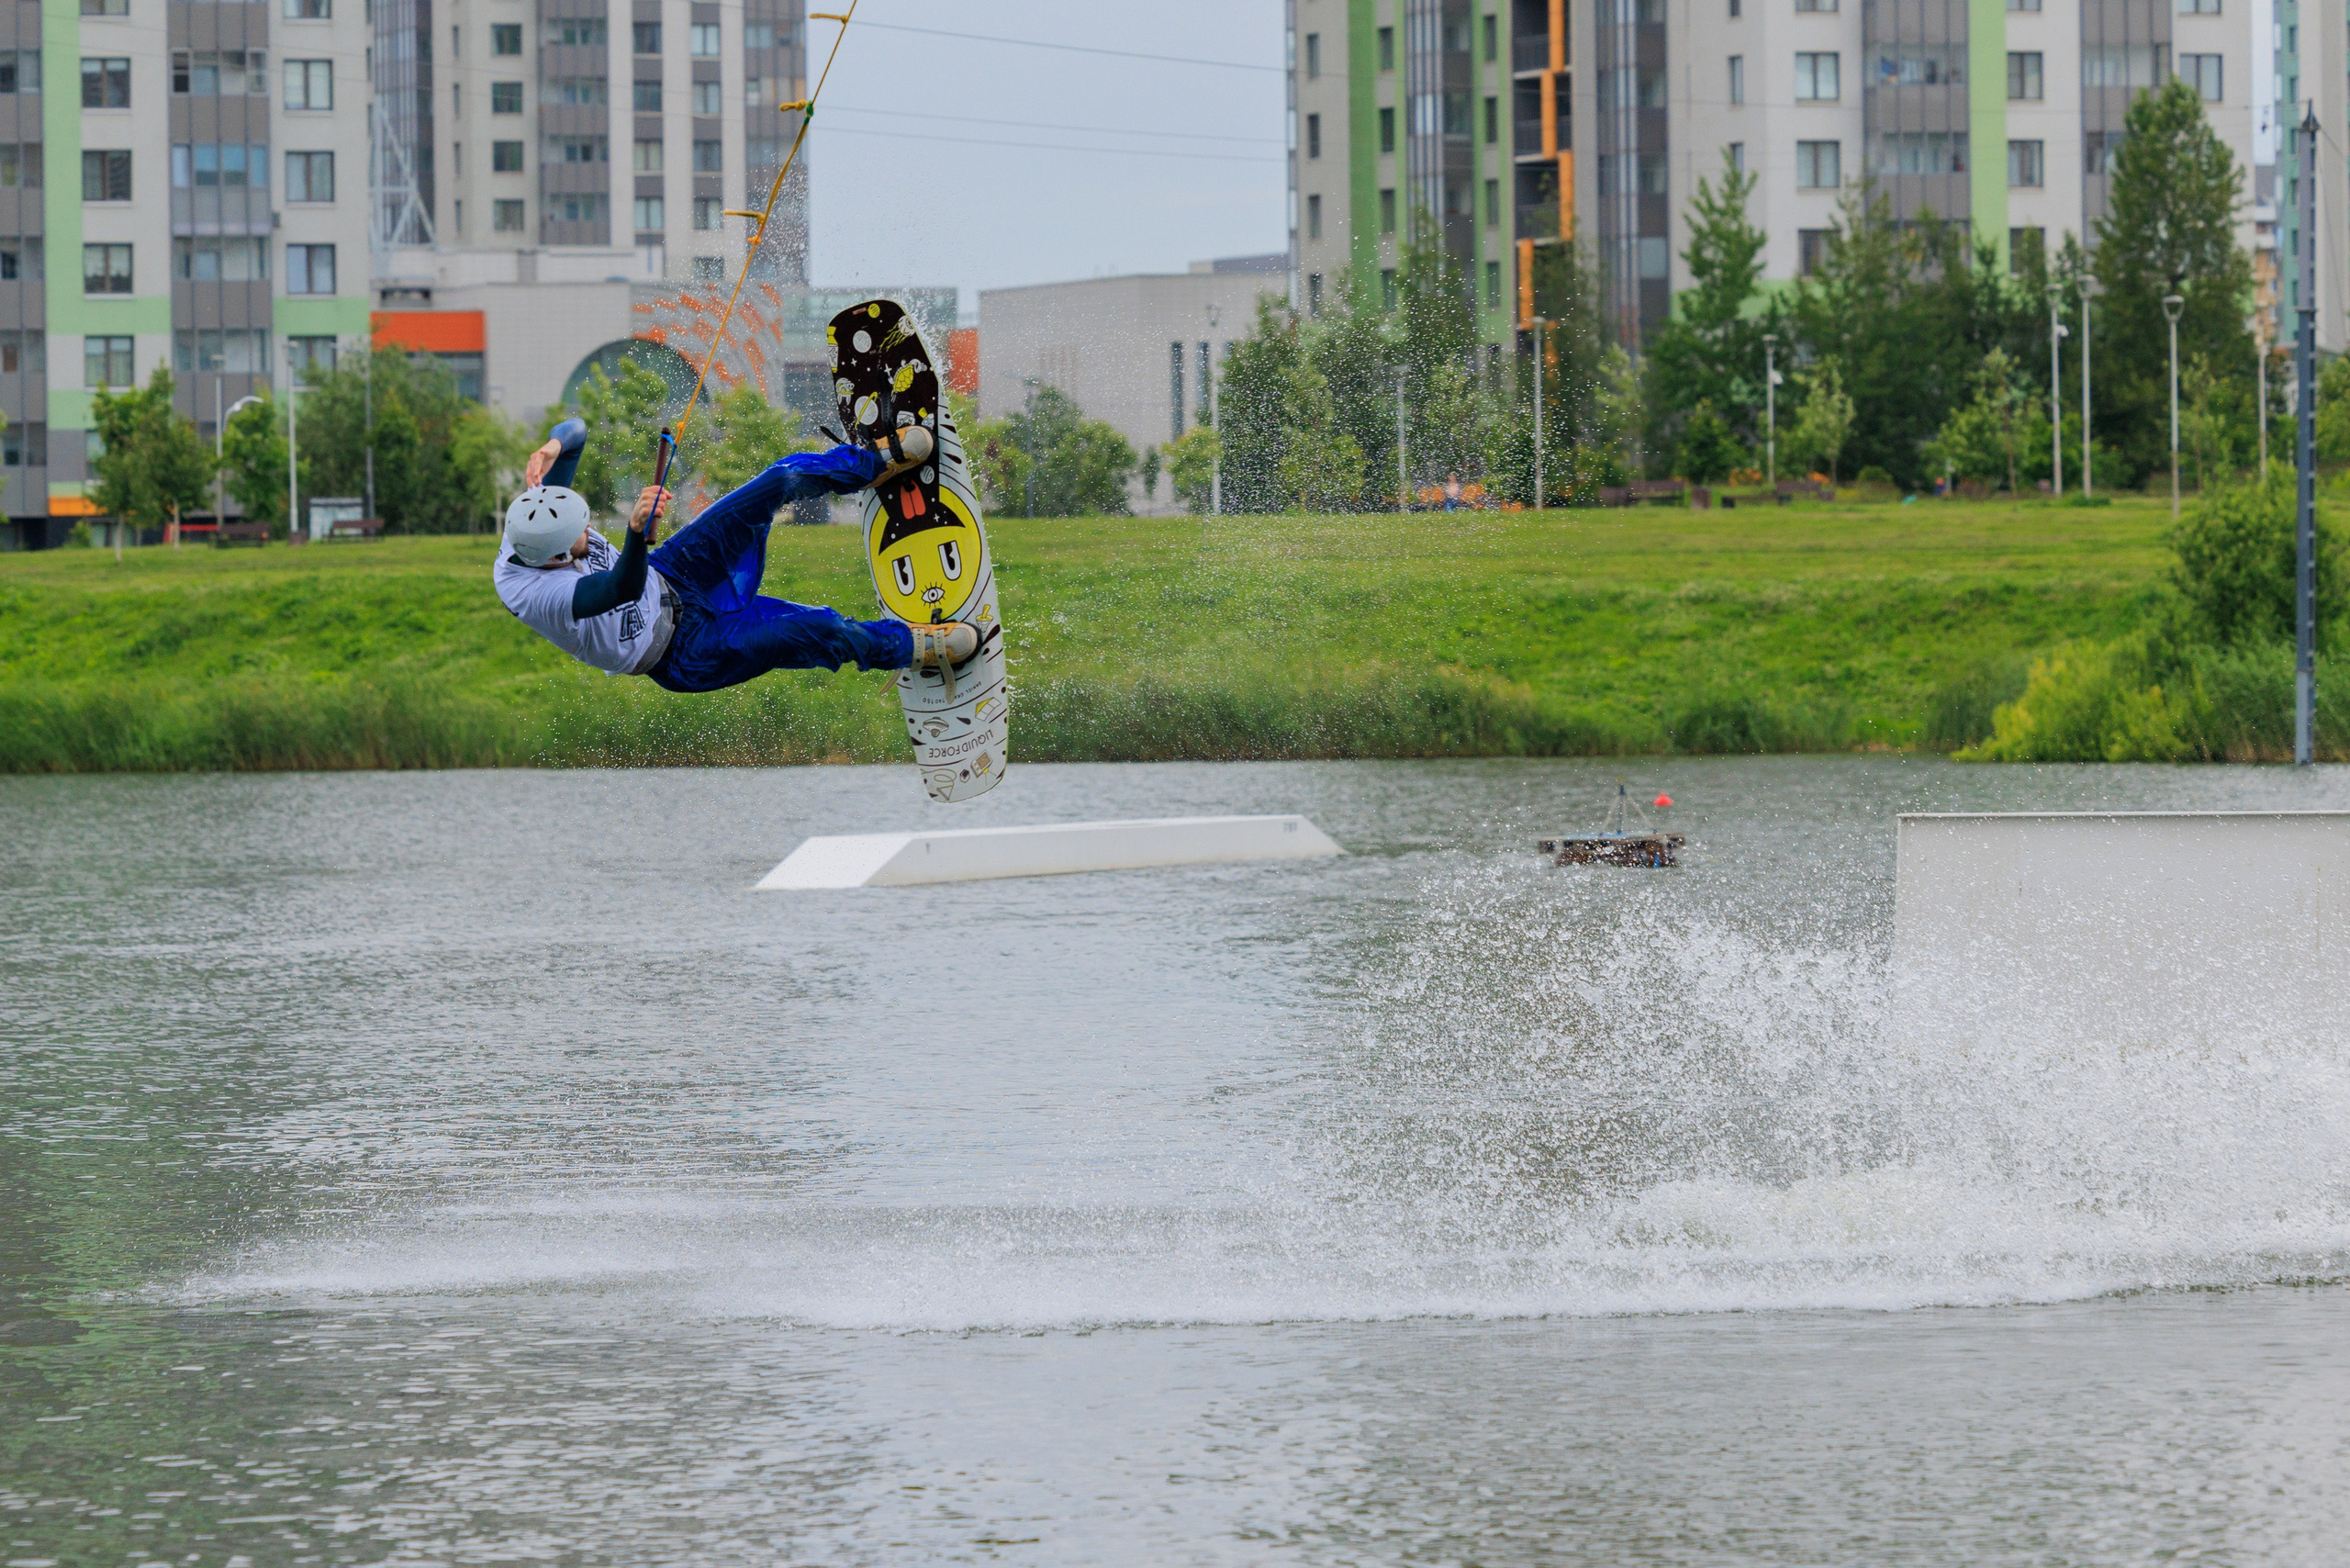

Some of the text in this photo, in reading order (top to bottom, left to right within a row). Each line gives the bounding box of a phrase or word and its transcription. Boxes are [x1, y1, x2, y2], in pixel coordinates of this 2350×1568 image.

[965, 681, 982, 694] DANIEL
[928, 729, 994, 758] LIQUID FORCE
